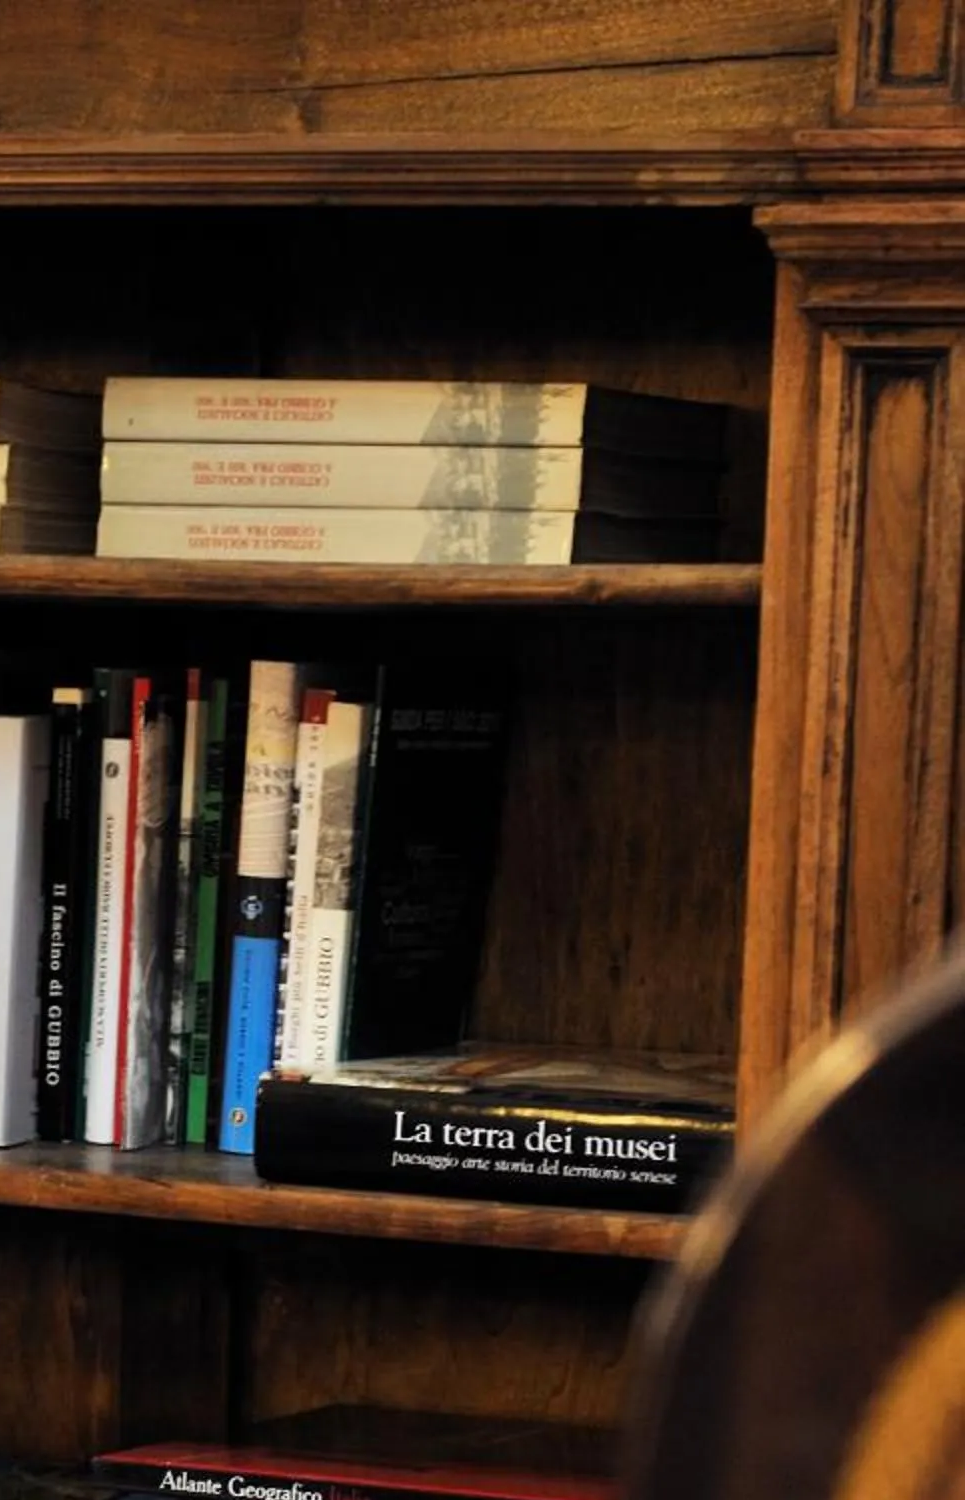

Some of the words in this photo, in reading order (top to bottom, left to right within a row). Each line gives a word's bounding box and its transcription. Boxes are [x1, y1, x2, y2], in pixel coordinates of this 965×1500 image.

[52, 882, 68, 897] Il
[48, 904, 68, 972] fascino
[46, 978, 63, 997] di
[315, 937, 335, 1018] GUBBIO
[45, 1004, 63, 1086] GUBBIO
[314, 1024, 332, 1042] di
[393, 1111, 432, 1144] La
[442, 1123, 515, 1151] terra
[524, 1119, 573, 1155] dei
[583, 1132, 678, 1163] musei
[391, 1149, 460, 1170] paesaggio
[462, 1157, 490, 1171] arte
[495, 1157, 534, 1174] storia
[536, 1158, 560, 1176] del
[563, 1163, 627, 1182] territorio
[630, 1171, 677, 1185] senese
[159, 1471, 222, 1496] Atlante
